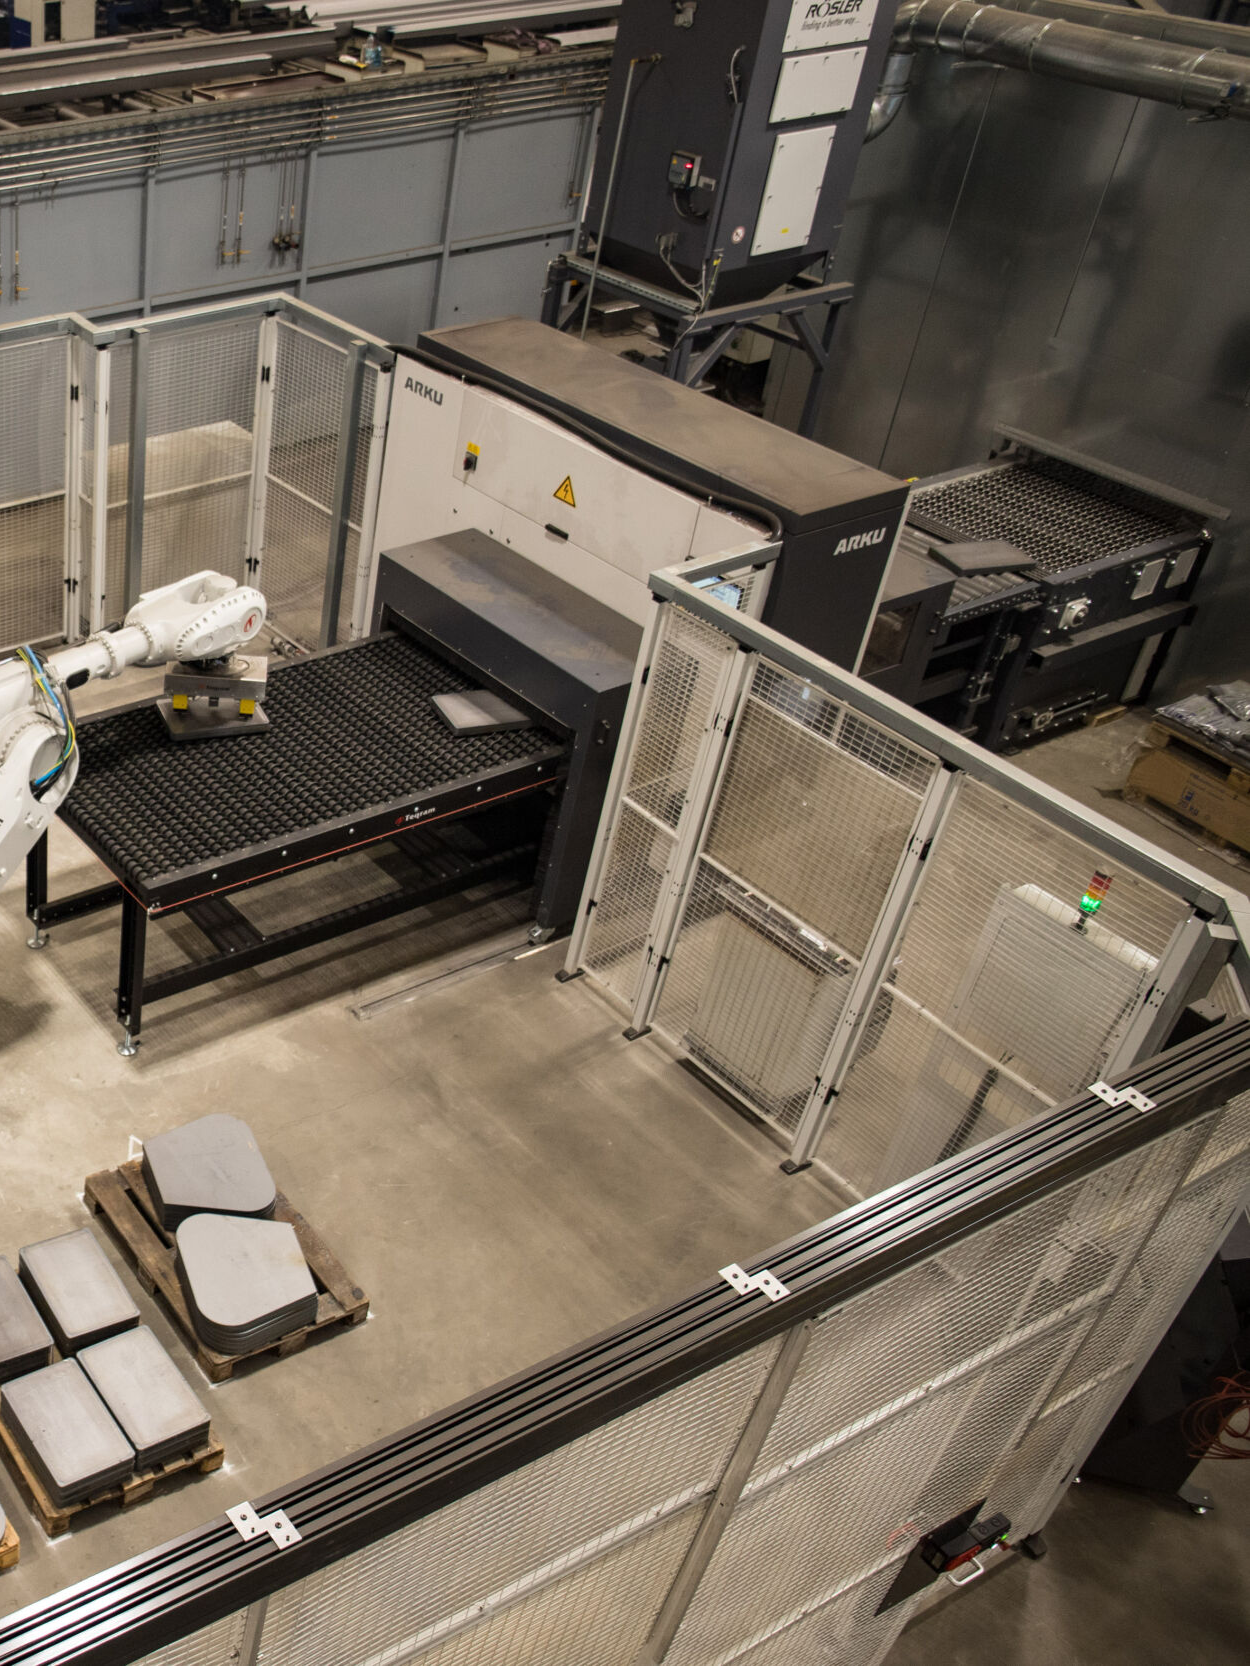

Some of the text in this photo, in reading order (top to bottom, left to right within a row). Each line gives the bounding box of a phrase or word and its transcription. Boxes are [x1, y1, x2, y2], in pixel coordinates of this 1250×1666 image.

[404, 376, 444, 407] ARKU
[833, 527, 886, 556] ARKU
[405, 807, 436, 822] Teqram
